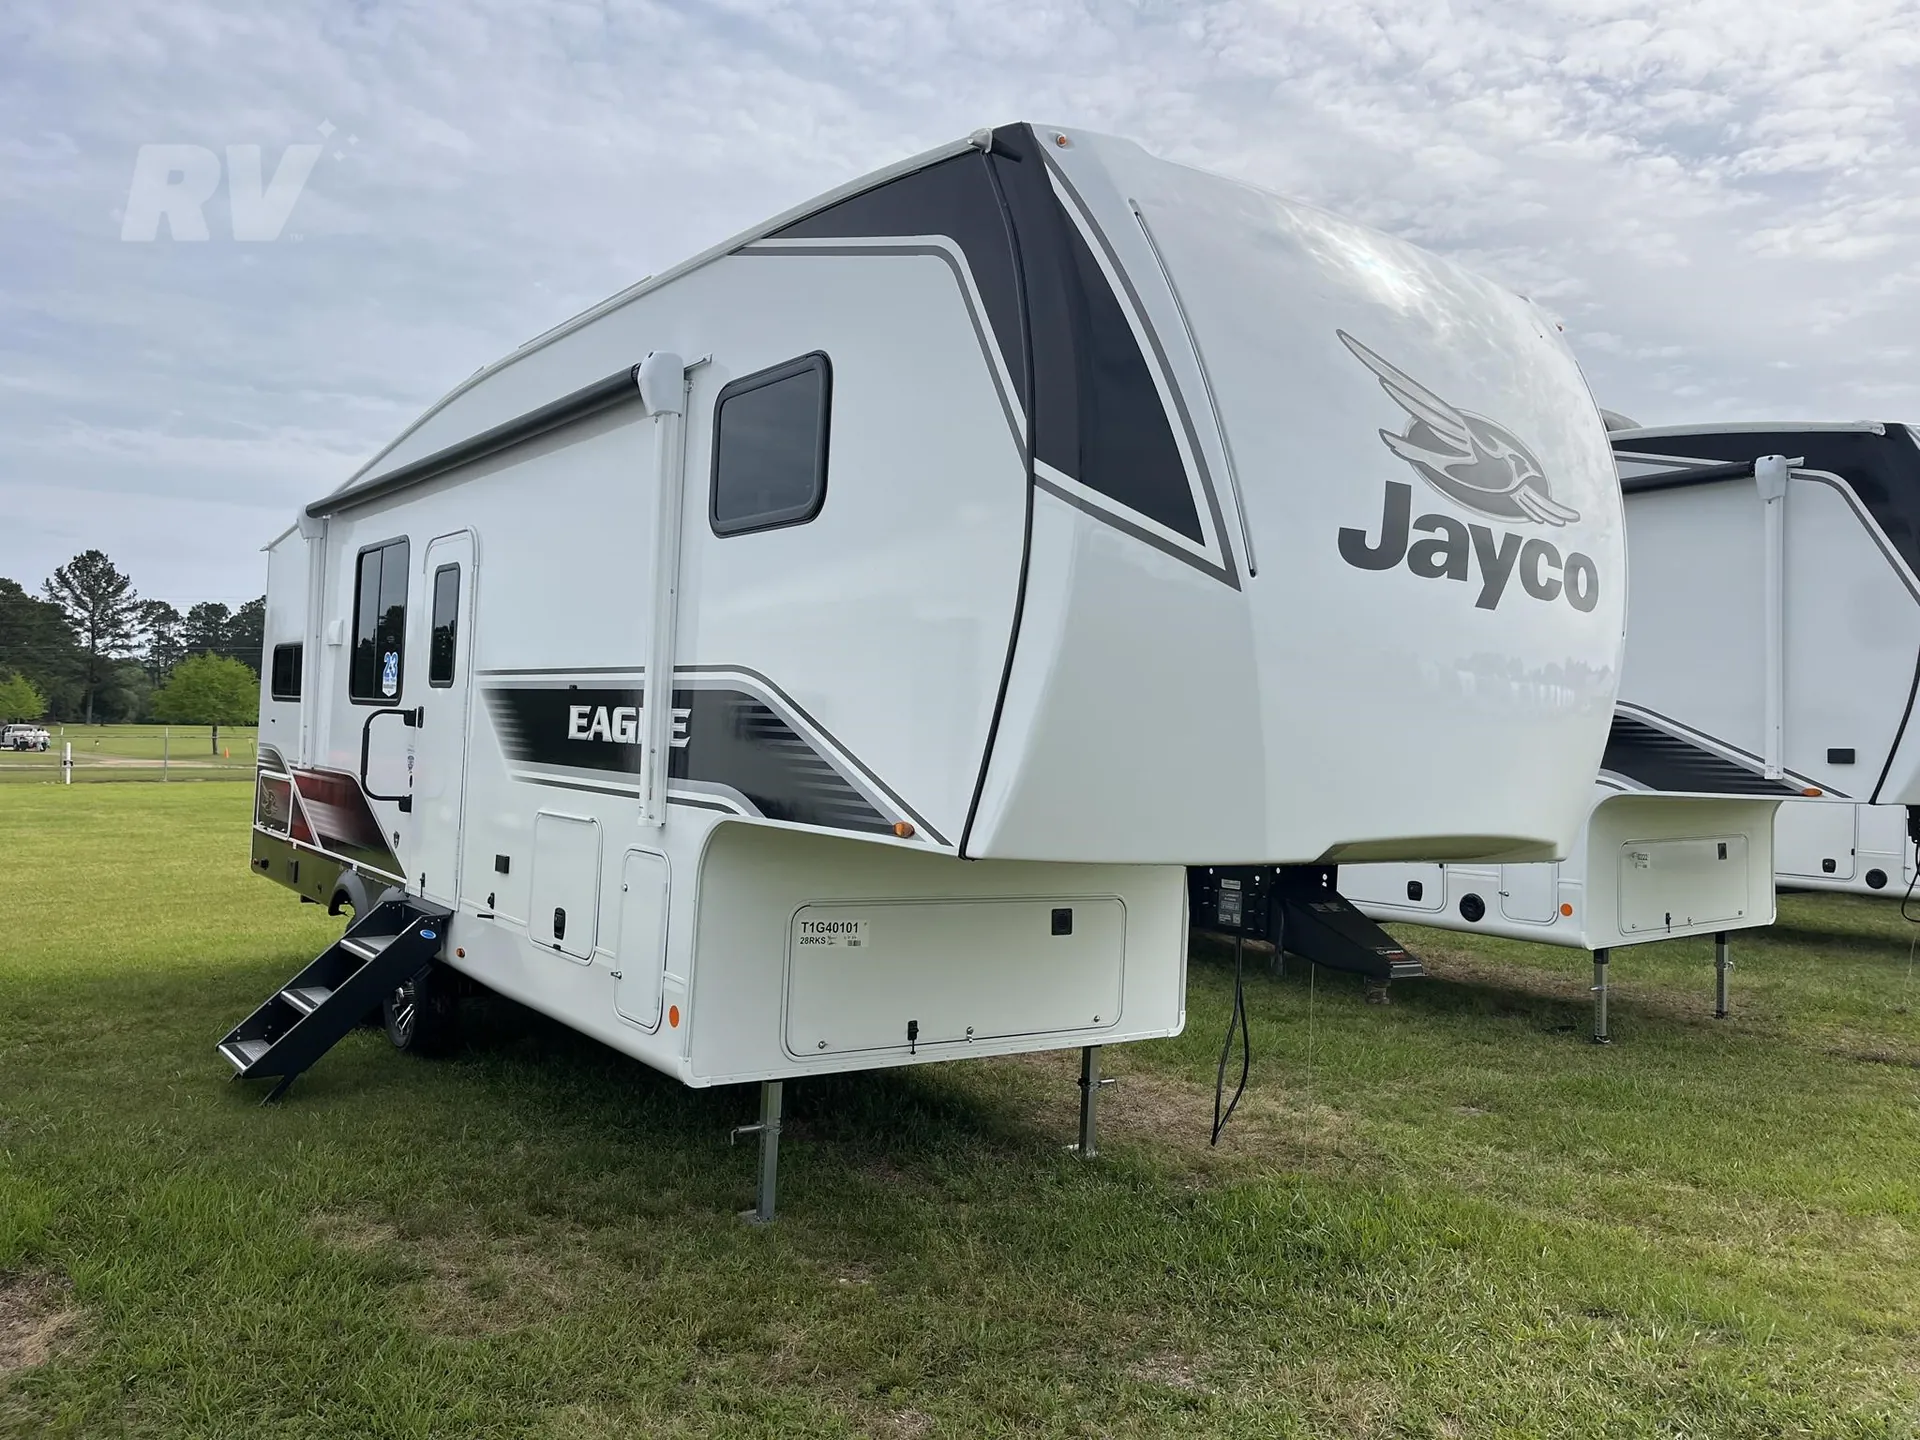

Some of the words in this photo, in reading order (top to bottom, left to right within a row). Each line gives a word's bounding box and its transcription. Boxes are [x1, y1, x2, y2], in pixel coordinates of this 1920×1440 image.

[1338, 480, 1599, 613] Jayco
[568, 705, 691, 747] EAGE
[800, 936, 826, 945] 28RKS
[801, 921, 858, 933] T1G40101
